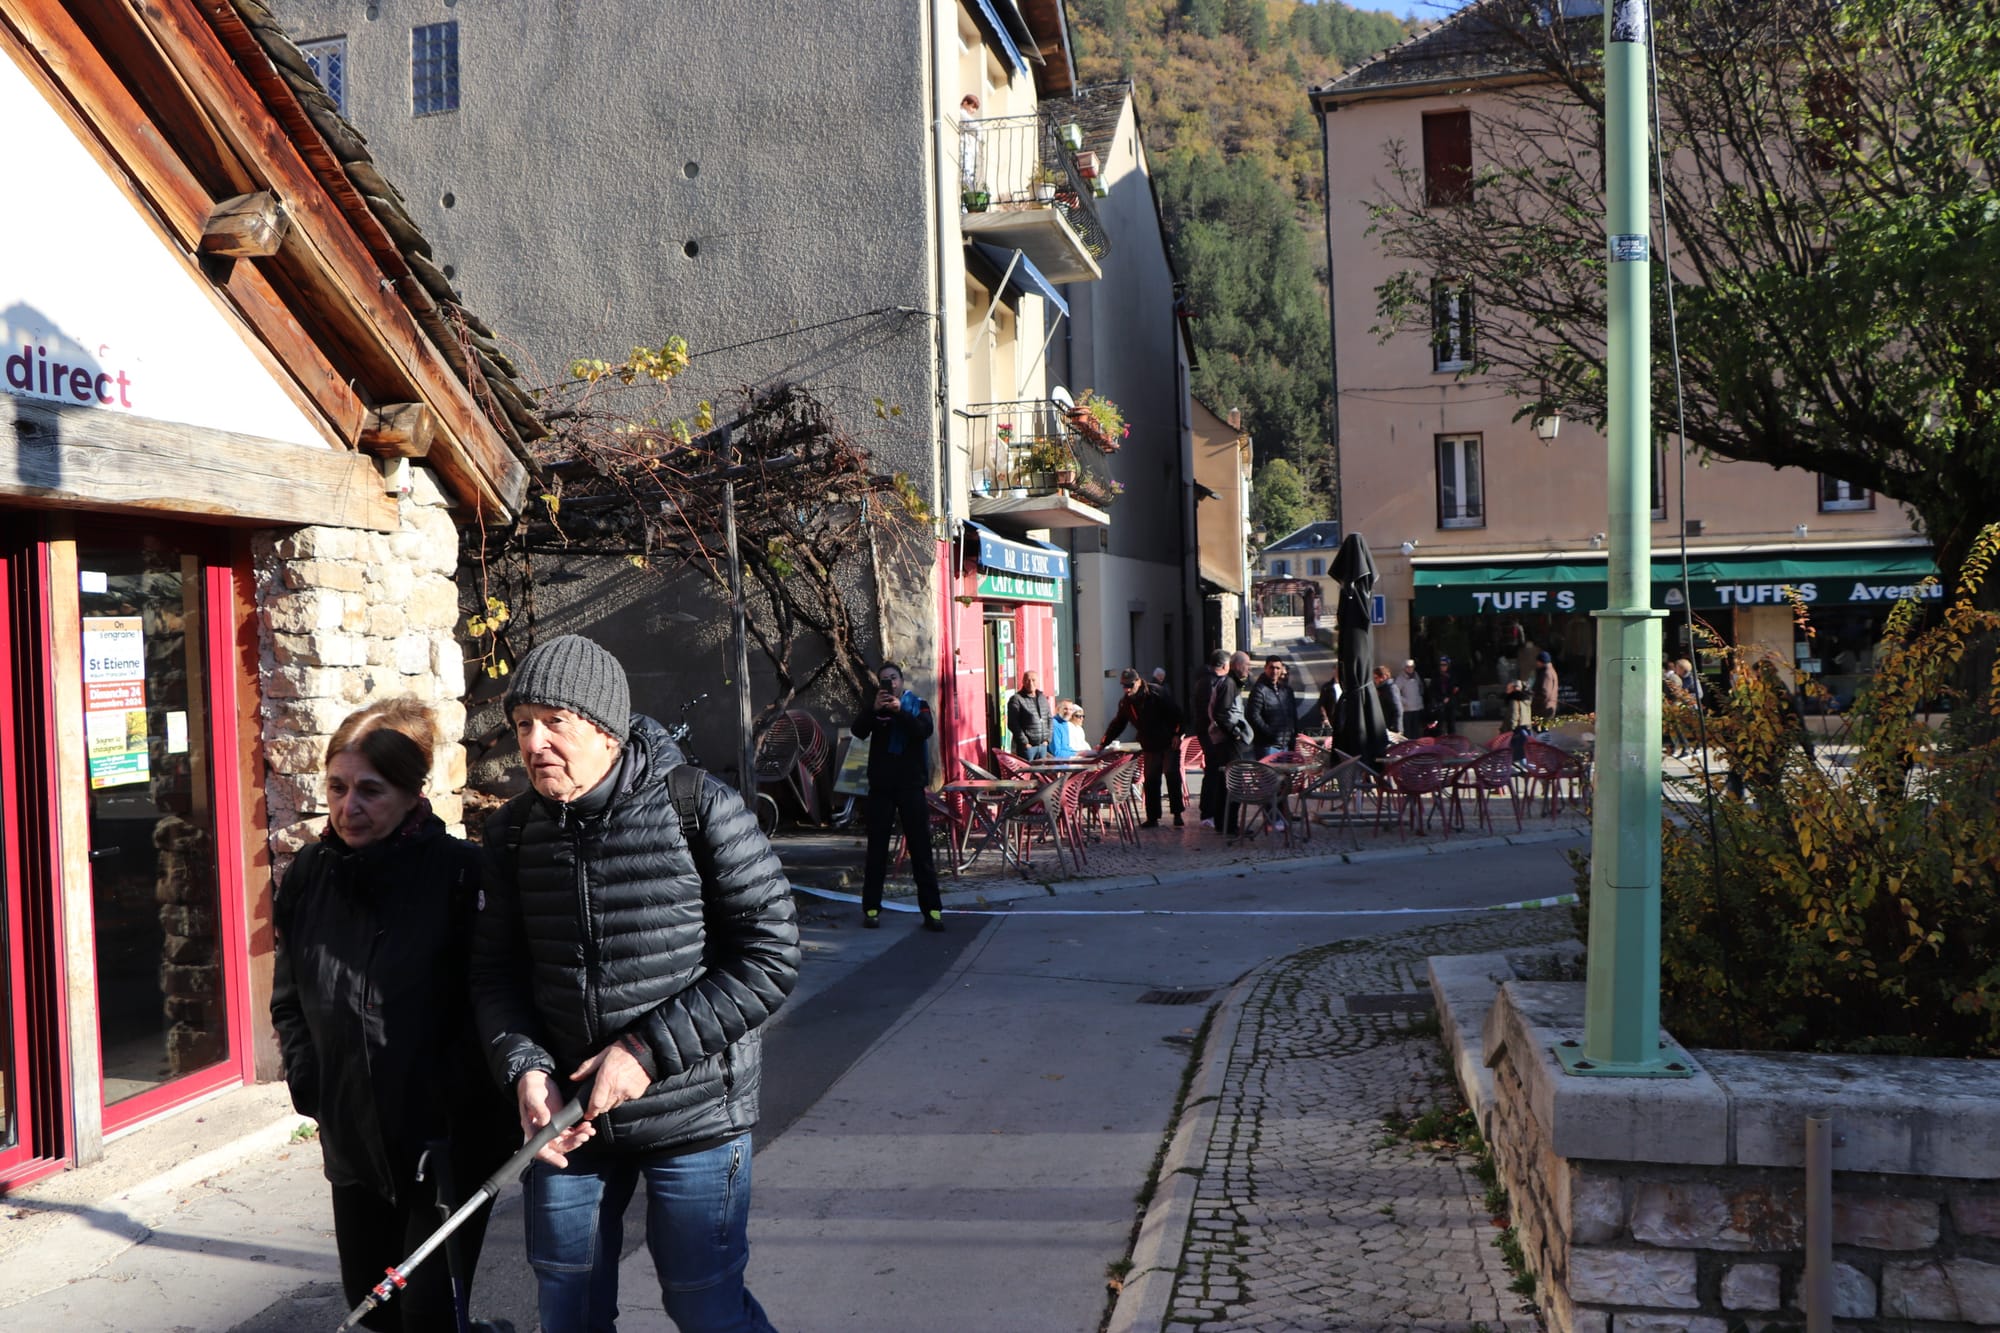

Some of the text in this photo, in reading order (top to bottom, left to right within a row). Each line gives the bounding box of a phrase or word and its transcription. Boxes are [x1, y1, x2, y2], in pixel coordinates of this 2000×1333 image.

[6, 344, 132, 408] direct
[1004, 548, 1016, 569] BAR
[1022, 552, 1030, 571] LE
[1472, 590, 1576, 610] TUFF'S
[114, 620, 125, 629] On
[89, 657, 140, 671] St Etienne
[90, 686, 141, 700] Dimanche 24
[125, 697, 142, 706] 2024
